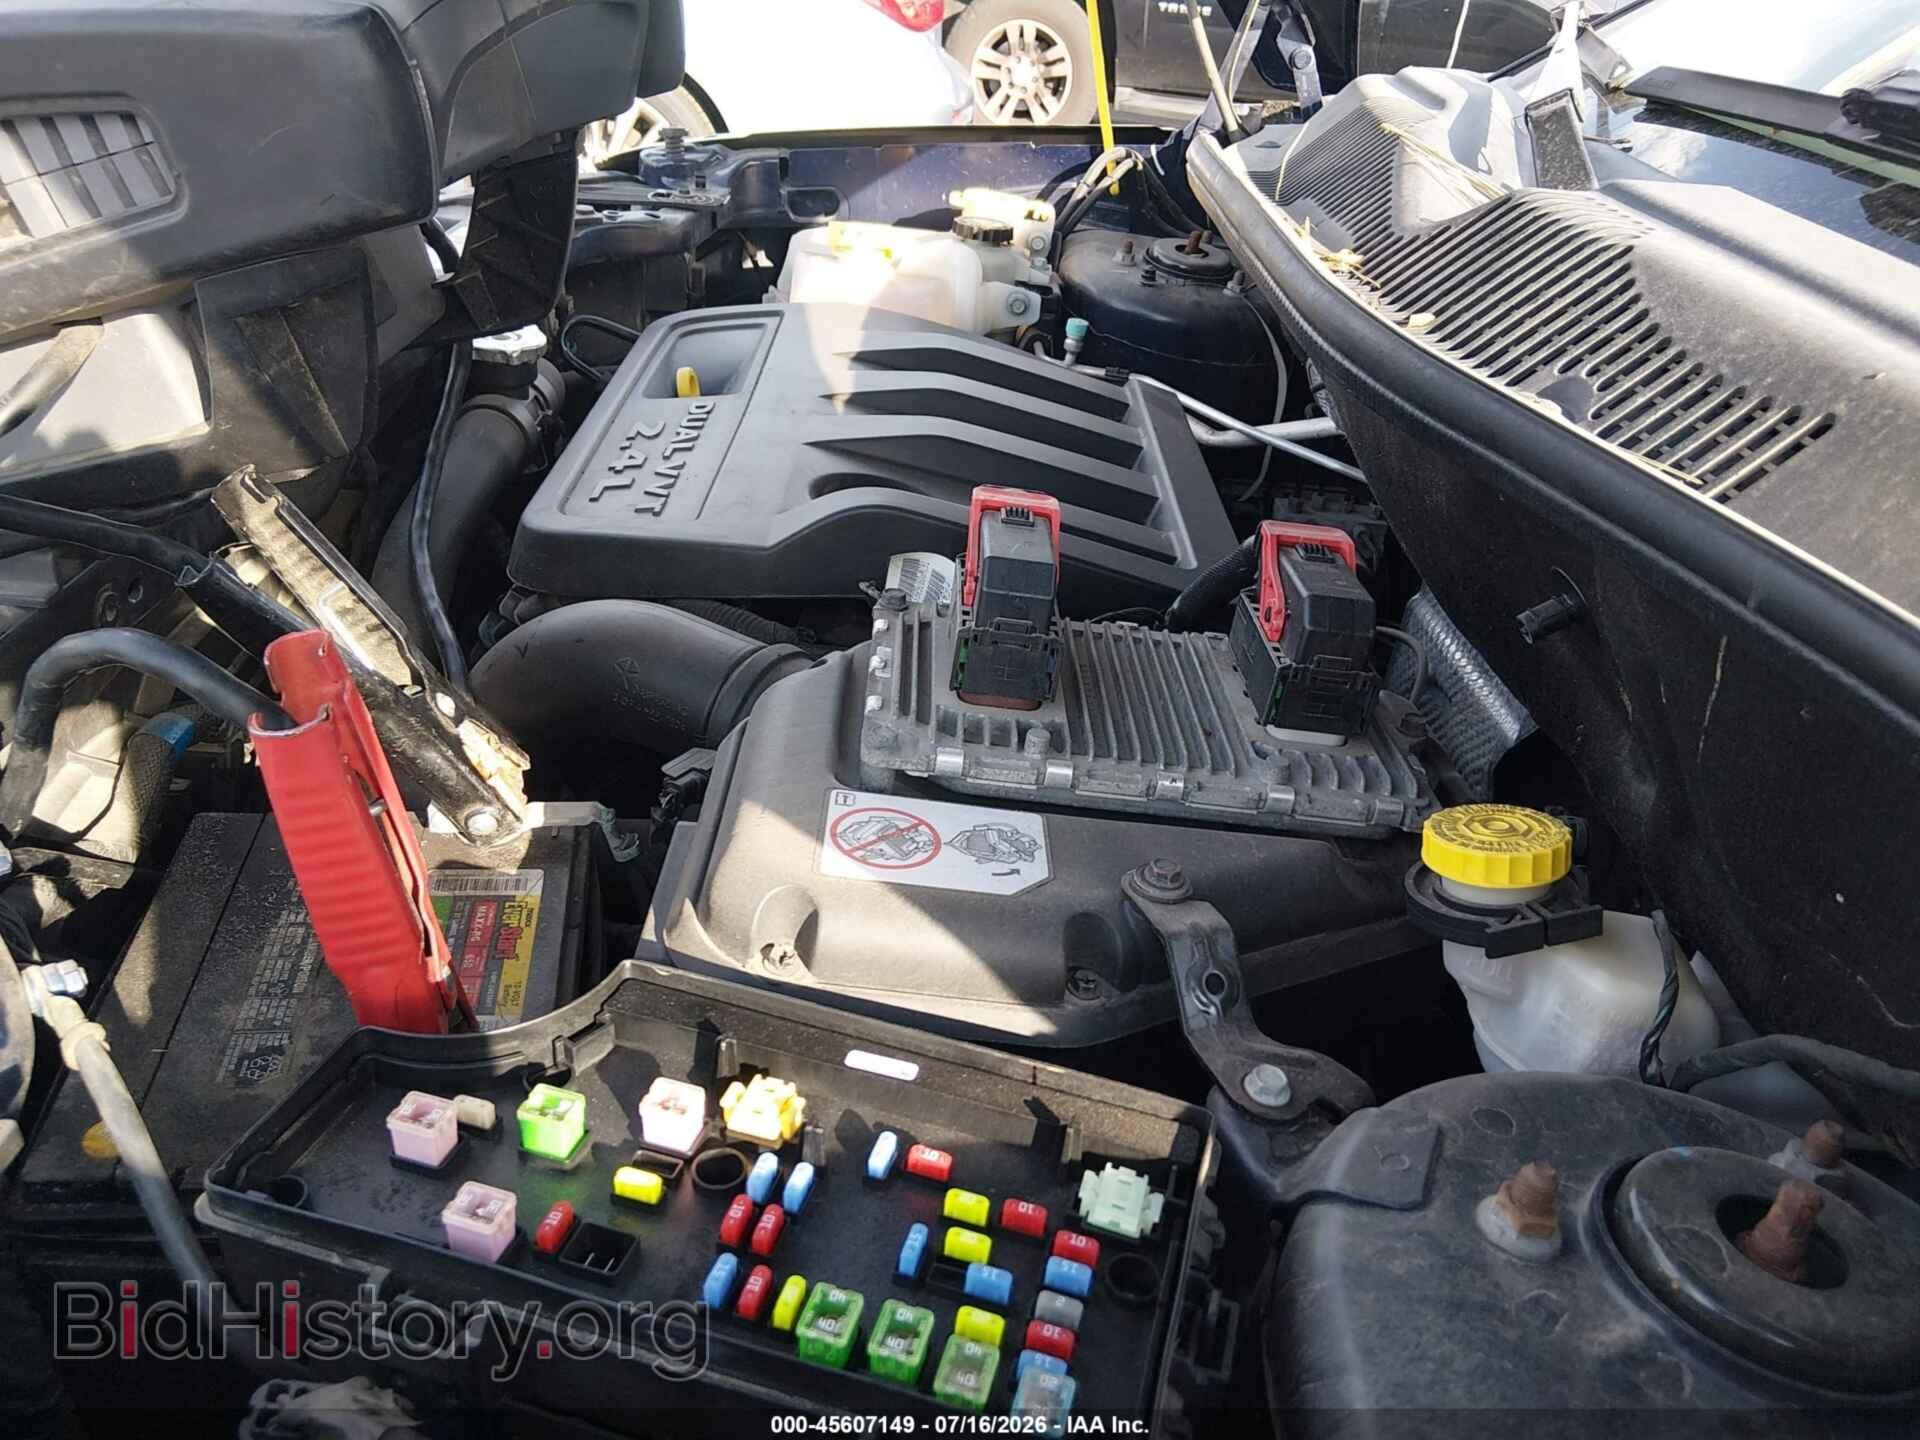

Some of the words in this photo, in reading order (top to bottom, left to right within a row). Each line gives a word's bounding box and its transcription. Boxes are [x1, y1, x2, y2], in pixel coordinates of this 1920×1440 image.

[663, 401, 716, 460] DUAL
[634, 461, 686, 517] VVT
[1018, 1202, 1034, 1215] 10
[1069, 1234, 1087, 1247] 10
[1042, 1324, 1062, 1338] 10
